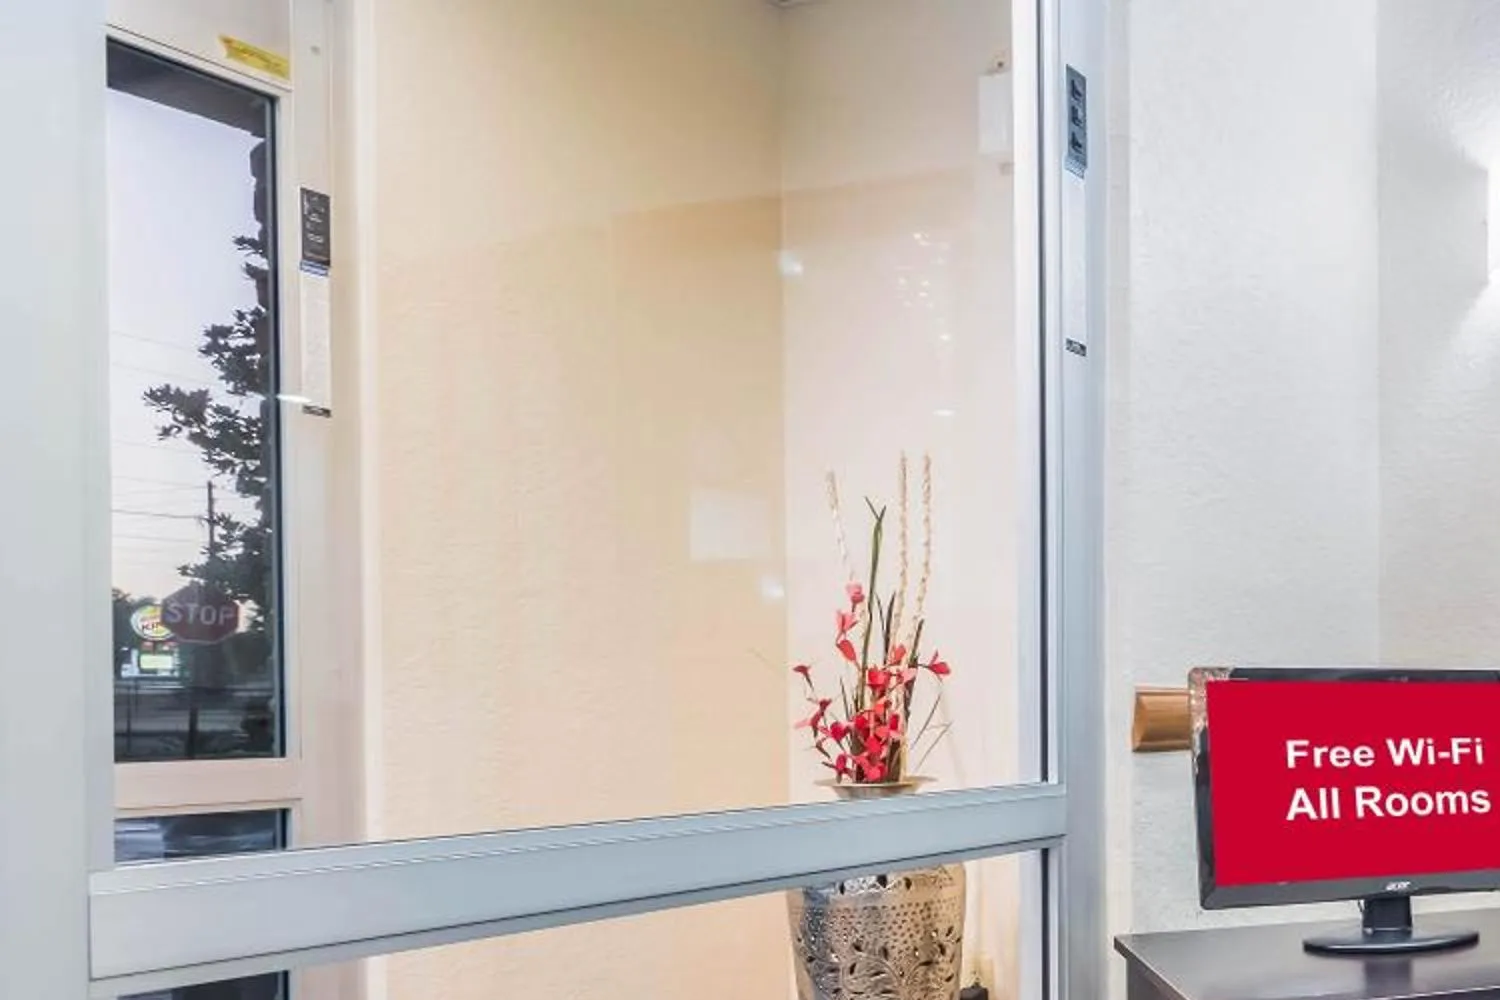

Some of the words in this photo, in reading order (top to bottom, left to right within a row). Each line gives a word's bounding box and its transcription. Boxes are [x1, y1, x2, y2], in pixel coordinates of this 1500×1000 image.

[166, 601, 235, 626] STOP
[1286, 740, 1375, 768] Free
[1386, 738, 1483, 765] Wi-Fi
[1286, 787, 1340, 820] All
[1355, 786, 1491, 818] Rooms
